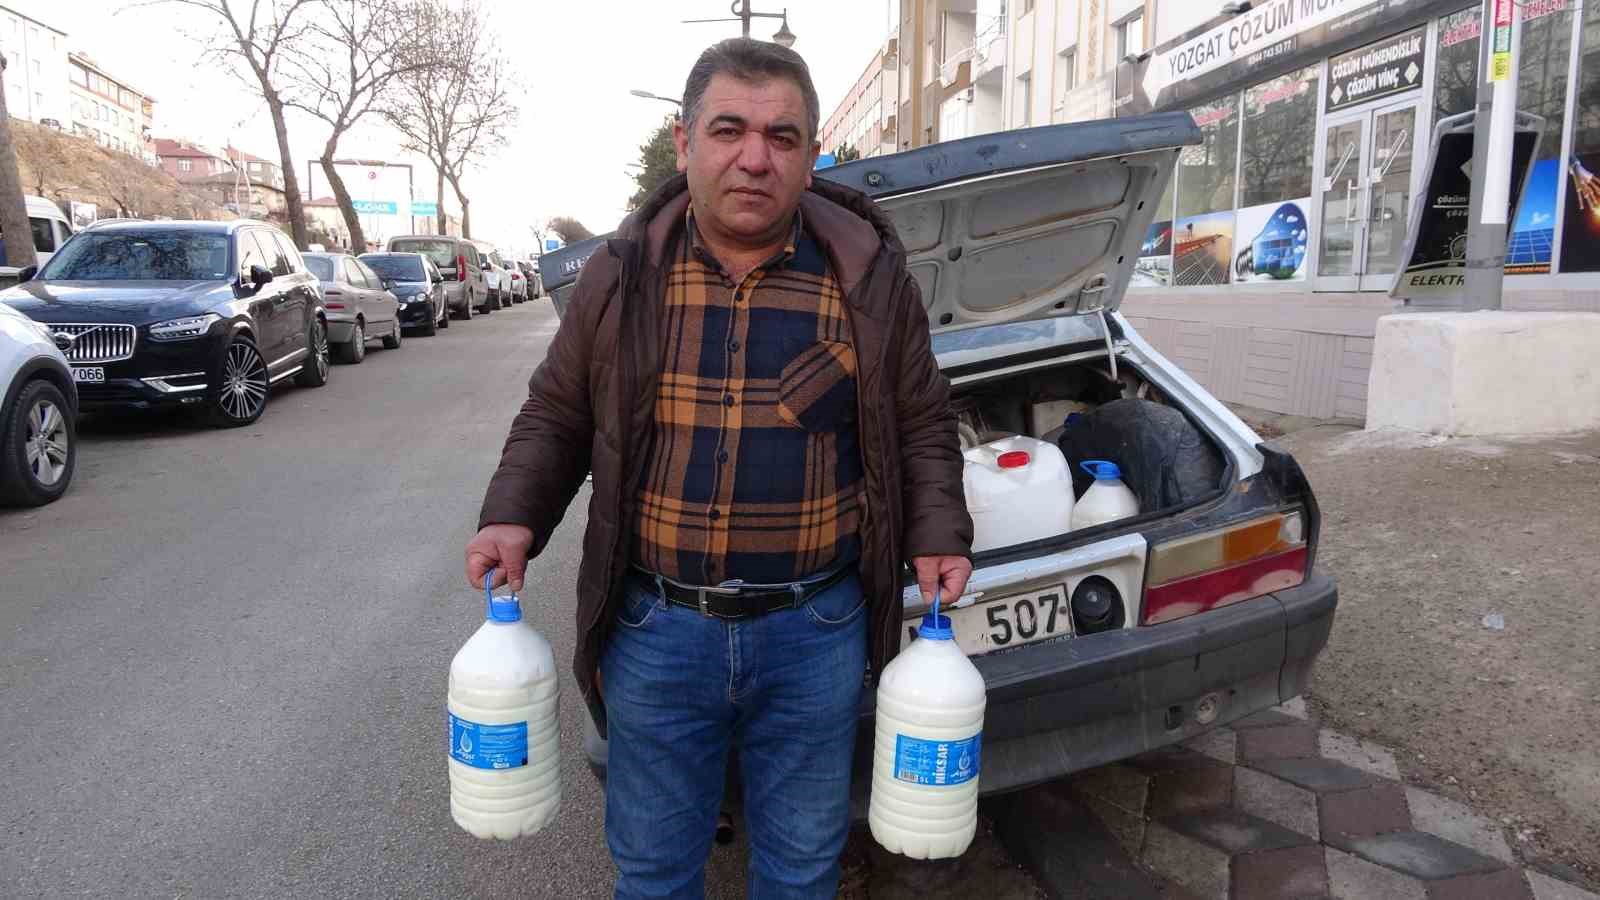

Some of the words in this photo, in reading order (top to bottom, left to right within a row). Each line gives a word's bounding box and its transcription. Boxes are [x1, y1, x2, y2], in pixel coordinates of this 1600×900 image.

[1169, 33, 1224, 80] YOZGAT
[1228, 0, 1294, 56] ÇÖZÜM
[1332, 55, 1362, 83] ÇÖZÜM
[1362, 35, 1422, 71] MÜHENDİSLİK
[1347, 70, 1377, 101] ÇÖZÜM
[1378, 65, 1400, 91] VİNÇ
[1409, 274, 1465, 287] ELEKTR
[79, 368, 103, 380] 066
[986, 593, 1060, 646] 507
